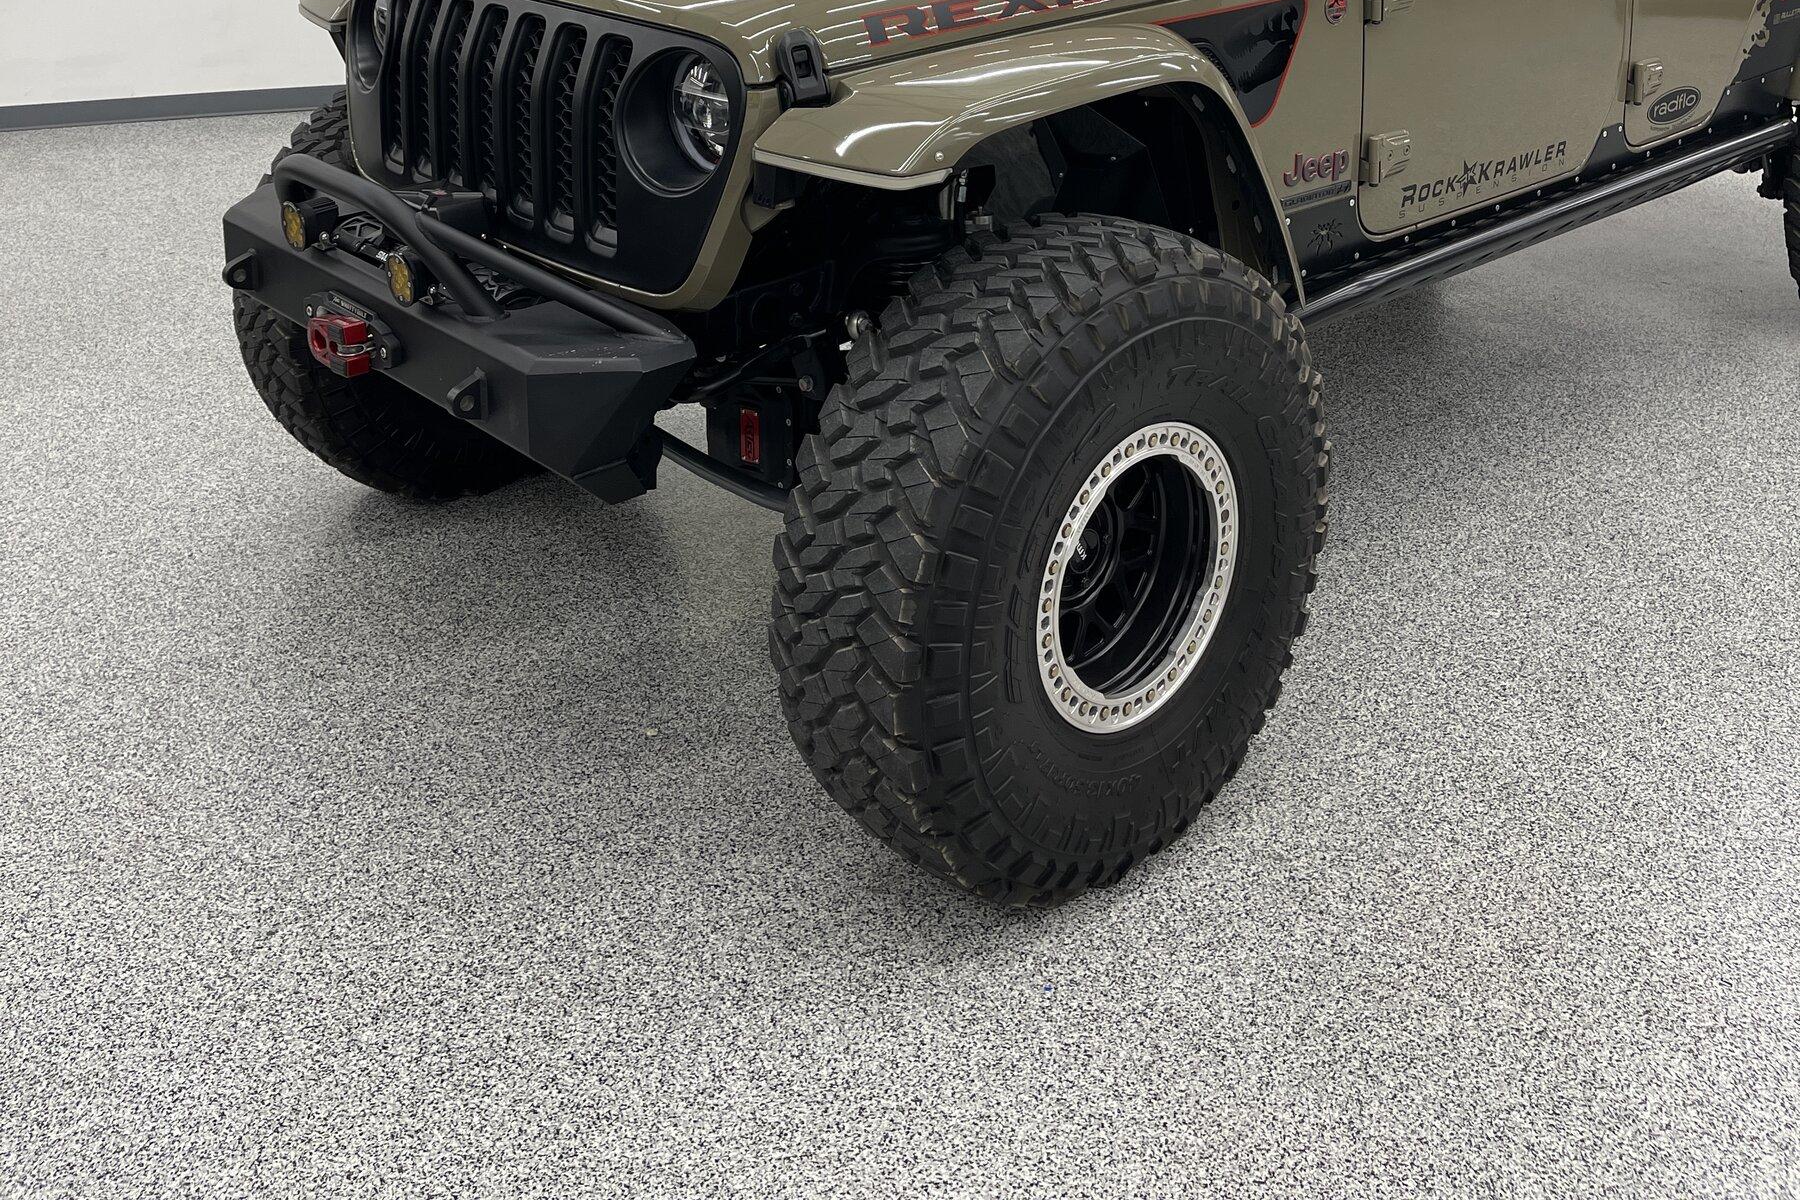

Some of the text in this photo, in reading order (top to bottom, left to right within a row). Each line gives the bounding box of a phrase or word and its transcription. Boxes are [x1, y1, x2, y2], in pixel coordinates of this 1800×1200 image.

[1654, 93, 1696, 117] radflo
[1283, 149, 1350, 188] Jeep
[1478, 140, 1567, 182] KRAWLER
